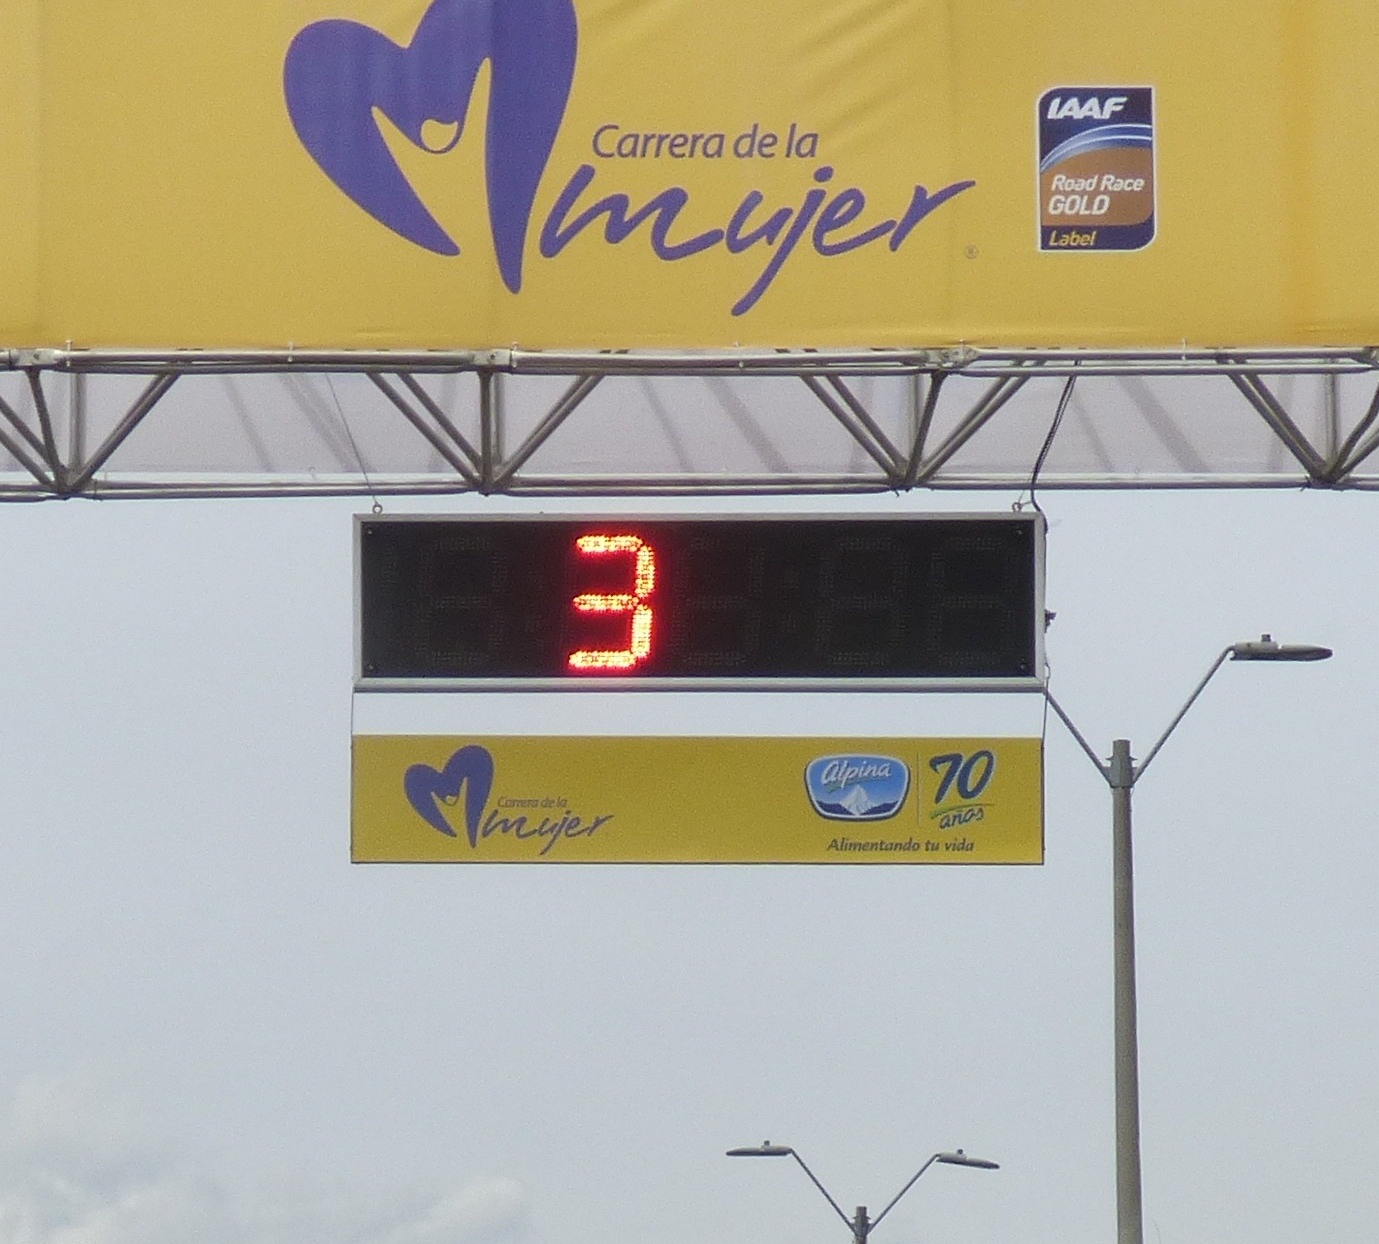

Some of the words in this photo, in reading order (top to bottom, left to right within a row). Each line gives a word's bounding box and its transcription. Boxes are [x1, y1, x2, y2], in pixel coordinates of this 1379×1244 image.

[1047, 97, 1128, 119] IAAF
[592, 124, 724, 158] Carrera
[733, 122, 778, 158] de
[785, 122, 819, 158] la
[1051, 174, 1098, 191] Road
[1101, 174, 1145, 191] Race
[1048, 195, 1110, 215] GOLD
[540, 164, 976, 317] mujer
[1049, 230, 1097, 246] Label
[568, 534, 655, 669] 3
[822, 760, 892, 789] Alpina
[929, 750, 995, 804] 70
[497, 796, 538, 808] Carrera
[540, 796, 555, 808] de
[556, 796, 568, 808] la
[482, 809, 615, 855] mujer
[827, 836, 920, 852] Alimentando
[924, 839, 940, 852] tu
[944, 837, 975, 852] vida
